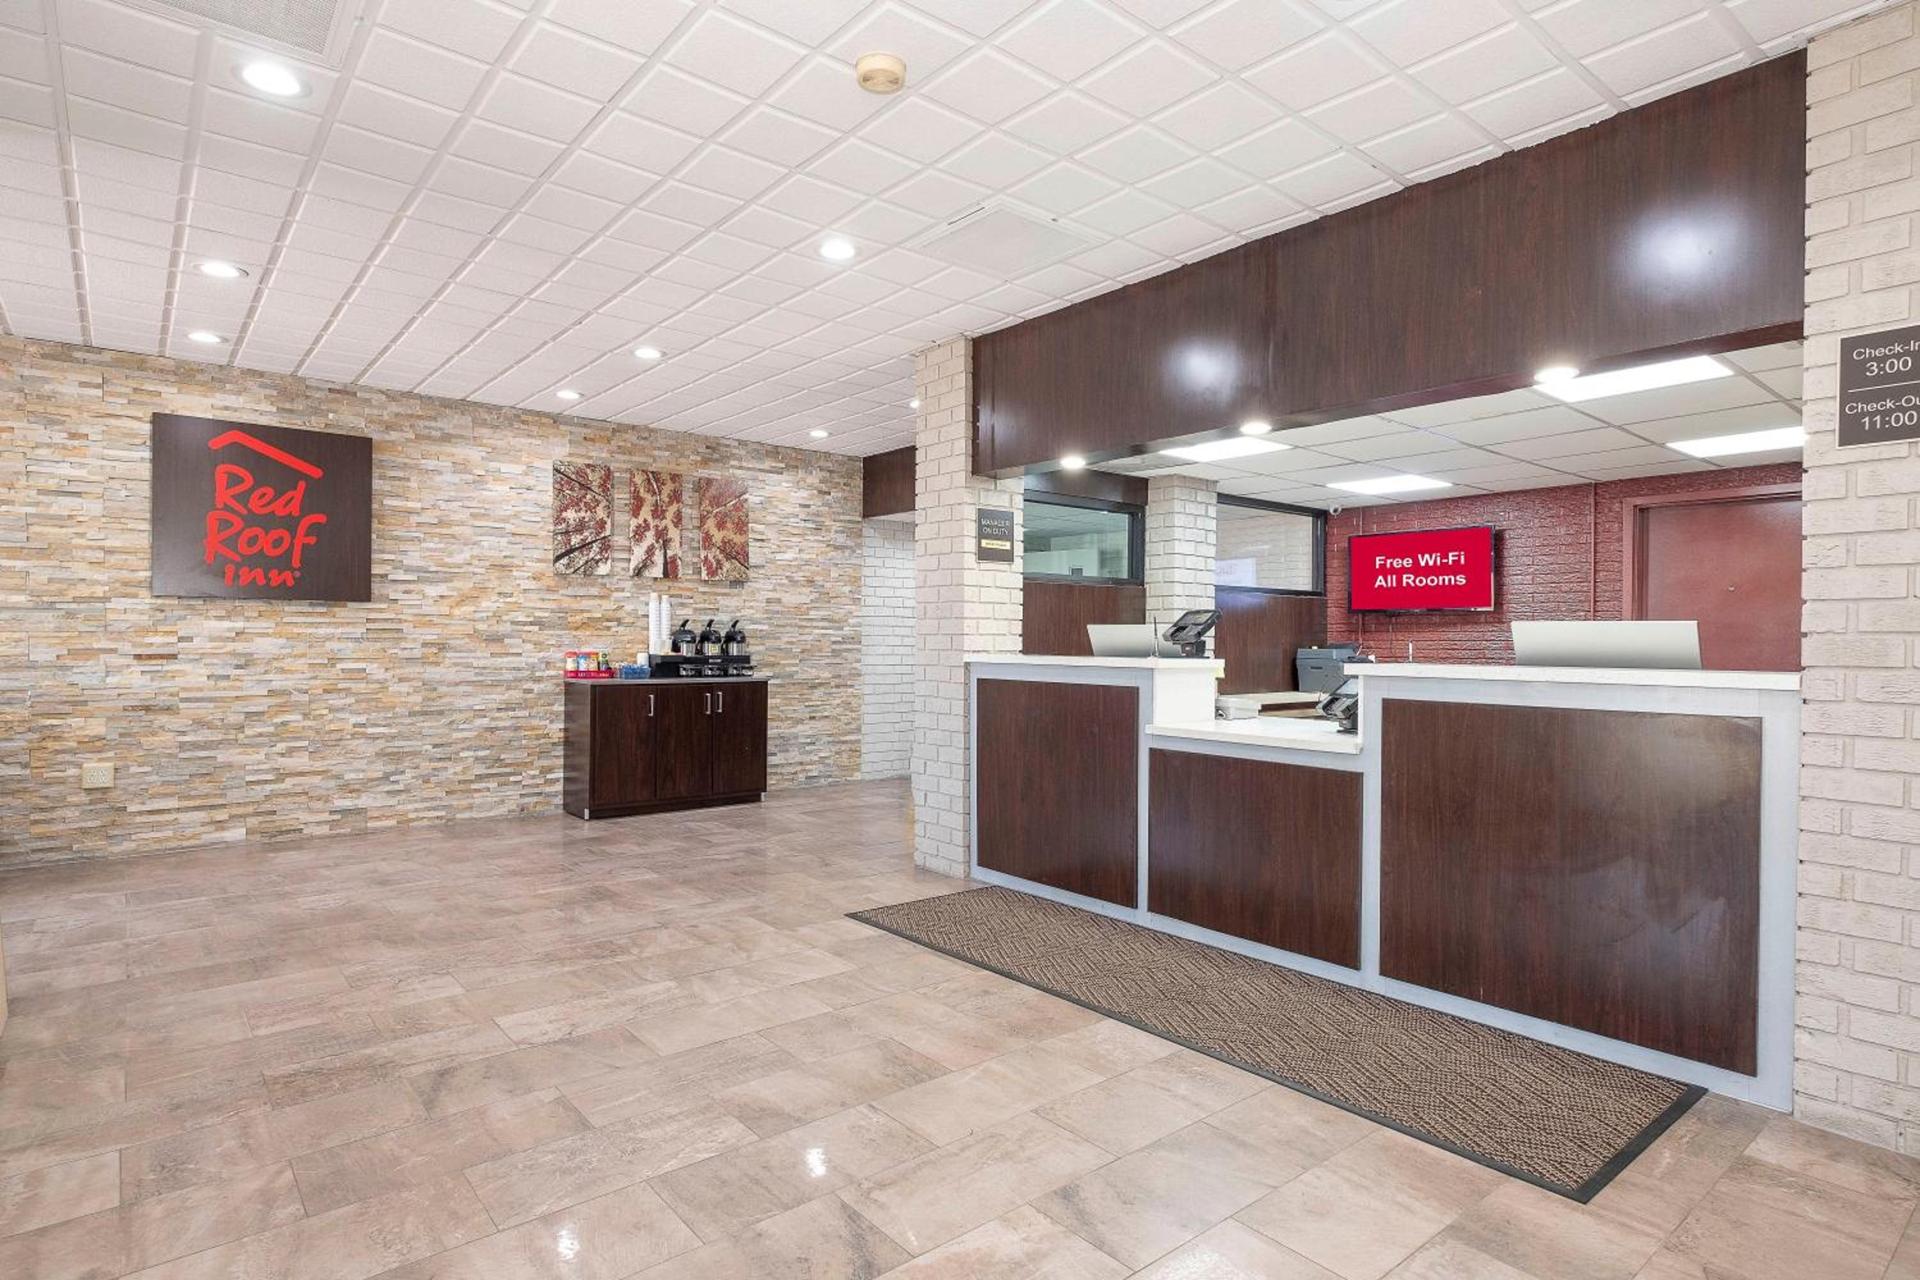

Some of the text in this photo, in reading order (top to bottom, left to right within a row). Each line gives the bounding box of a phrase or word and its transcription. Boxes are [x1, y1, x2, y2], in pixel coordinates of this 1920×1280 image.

[1865, 356, 1912, 376] 3:00
[1861, 410, 1918, 431] 11:00
[214, 463, 306, 517] Red
[203, 510, 328, 568] Roof
[1375, 551, 1465, 569] Free Wi-Fi
[1374, 574, 1467, 588] All Rooms
